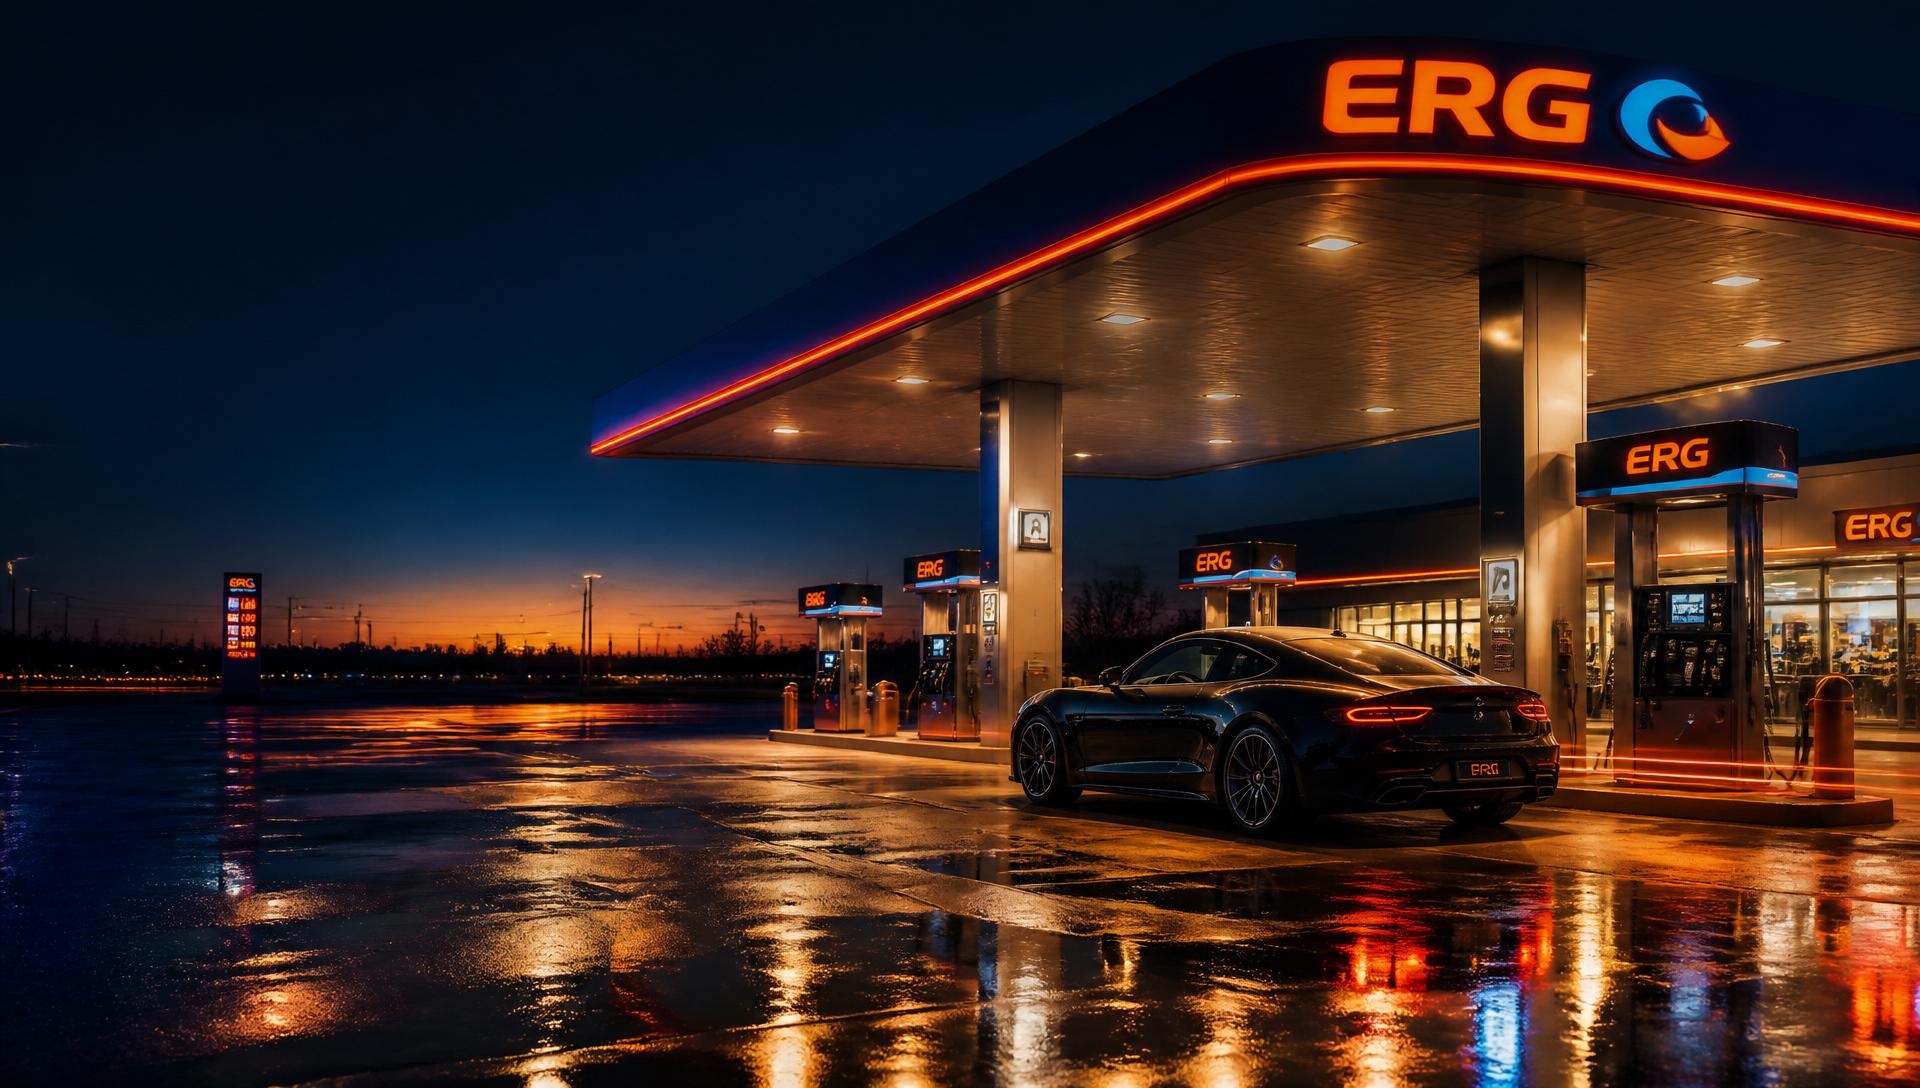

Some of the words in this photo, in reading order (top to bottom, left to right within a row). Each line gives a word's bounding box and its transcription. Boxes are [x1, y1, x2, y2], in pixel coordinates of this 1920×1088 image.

[1323, 59, 1591, 143] ERG
[1626, 438, 1709, 475] ERG
[1845, 511, 1912, 541] ERG
[917, 559, 944, 579] ERG
[1196, 550, 1232, 572] ERG
